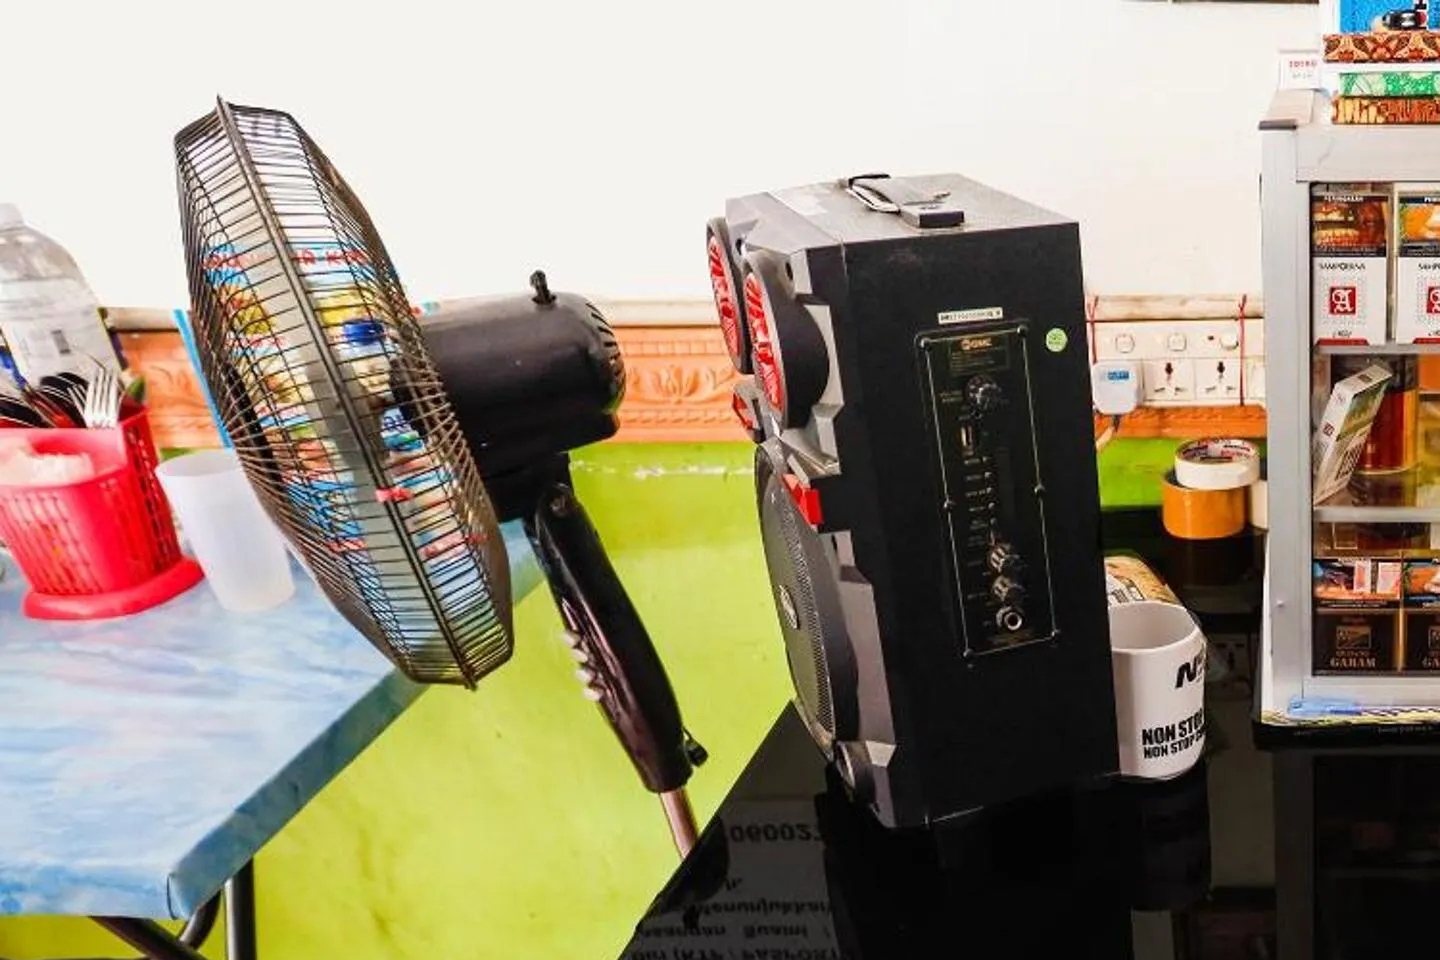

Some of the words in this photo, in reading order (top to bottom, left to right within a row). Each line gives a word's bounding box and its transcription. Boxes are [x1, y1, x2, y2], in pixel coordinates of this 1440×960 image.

[1142, 723, 1176, 746] NON
[1143, 744, 1169, 759] NON
[1170, 734, 1195, 755] STOP
